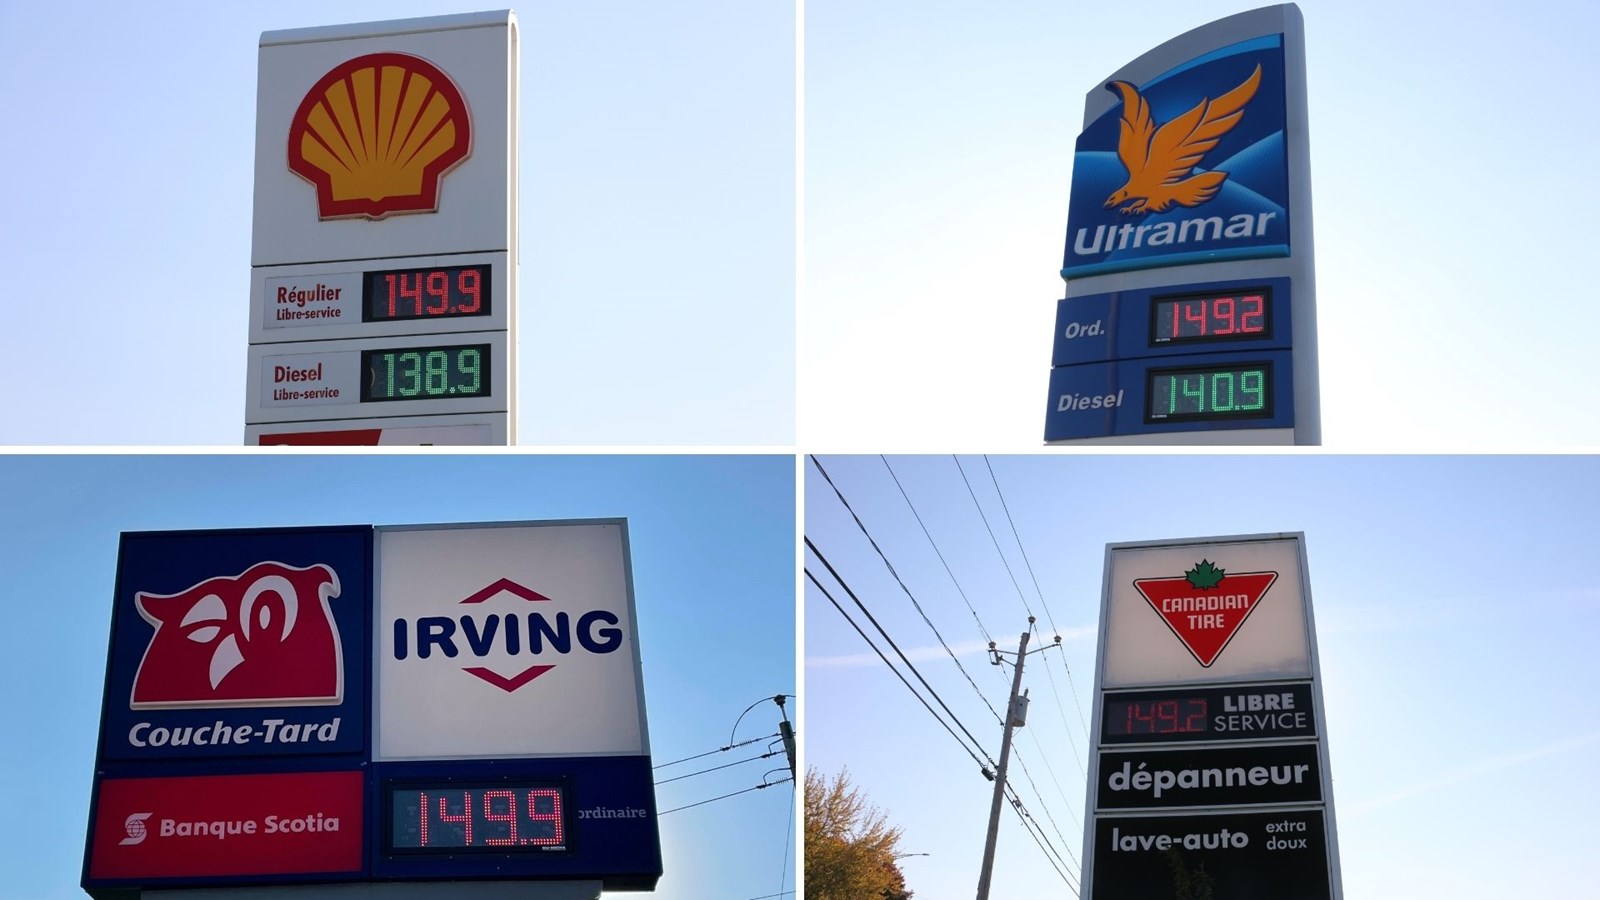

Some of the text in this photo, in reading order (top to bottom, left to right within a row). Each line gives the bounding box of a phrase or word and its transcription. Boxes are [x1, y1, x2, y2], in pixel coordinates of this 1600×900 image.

[1073, 211, 1277, 255] Ultramar
[277, 284, 342, 307] Régulier
[385, 269, 481, 317] 149.9
[276, 307, 341, 321] Libre-service
[1171, 296, 1264, 338] 149.2
[1065, 320, 1105, 339] Ord.
[274, 363, 322, 383] Diesel
[384, 349, 480, 397] 138.9
[273, 388, 340, 401] Libre-service
[1057, 390, 1124, 412] Diesel
[1170, 370, 1264, 414] 140.9
[1162, 594, 1249, 613] CANADIAN
[1187, 613, 1225, 630] TIRE
[393, 610, 623, 660] IRVING
[1223, 693, 1295, 712] LIBRE
[1126, 698, 1208, 734] 149.2
[1214, 712, 1307, 732] SERVICE
[128, 717, 341, 747] Couche-Tard
[1108, 761, 1309, 798] dépanneur
[160, 812, 340, 840] Banque Scotia
[419, 789, 563, 847] 149.9
[1265, 820, 1306, 833] extra
[1111, 828, 1249, 852] lave-auto
[1266, 836, 1308, 850] doux
